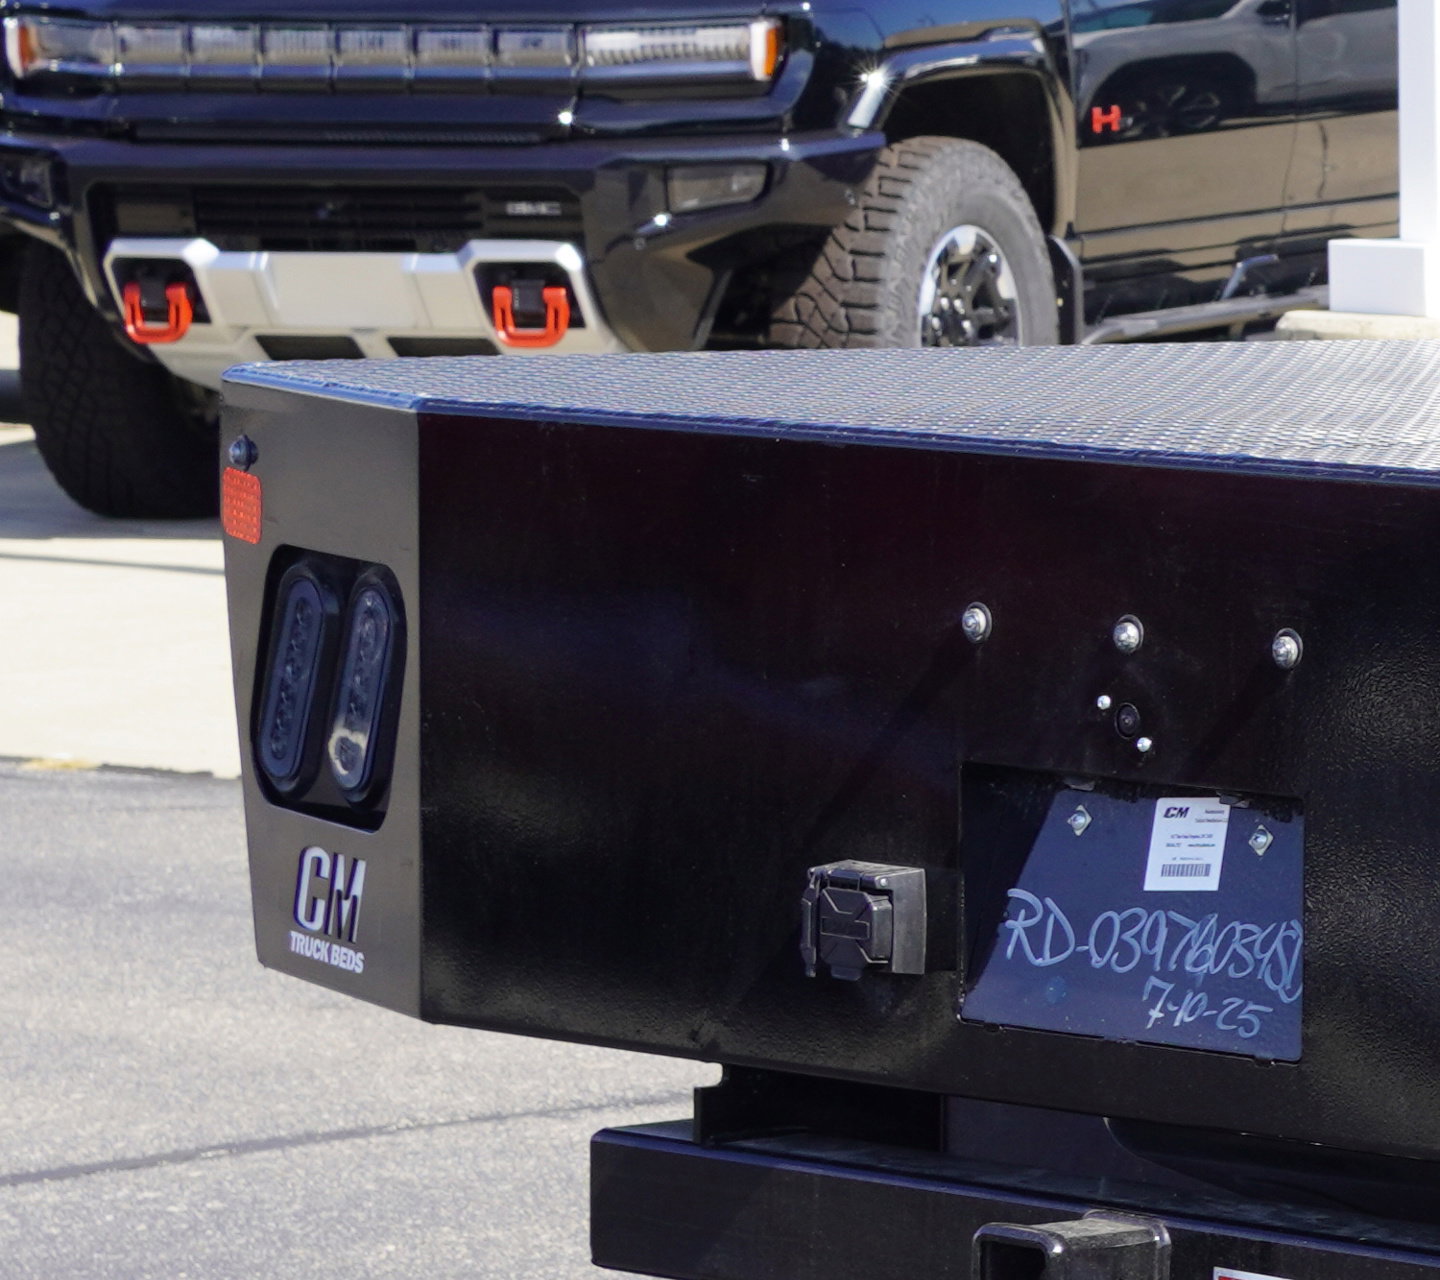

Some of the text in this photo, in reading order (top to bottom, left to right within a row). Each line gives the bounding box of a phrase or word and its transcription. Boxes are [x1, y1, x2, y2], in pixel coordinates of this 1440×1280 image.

[293, 846, 367, 942] CM
[290, 930, 365, 974] TRUCK BEDS
[1142, 975, 1274, 1039] 7-10-25
